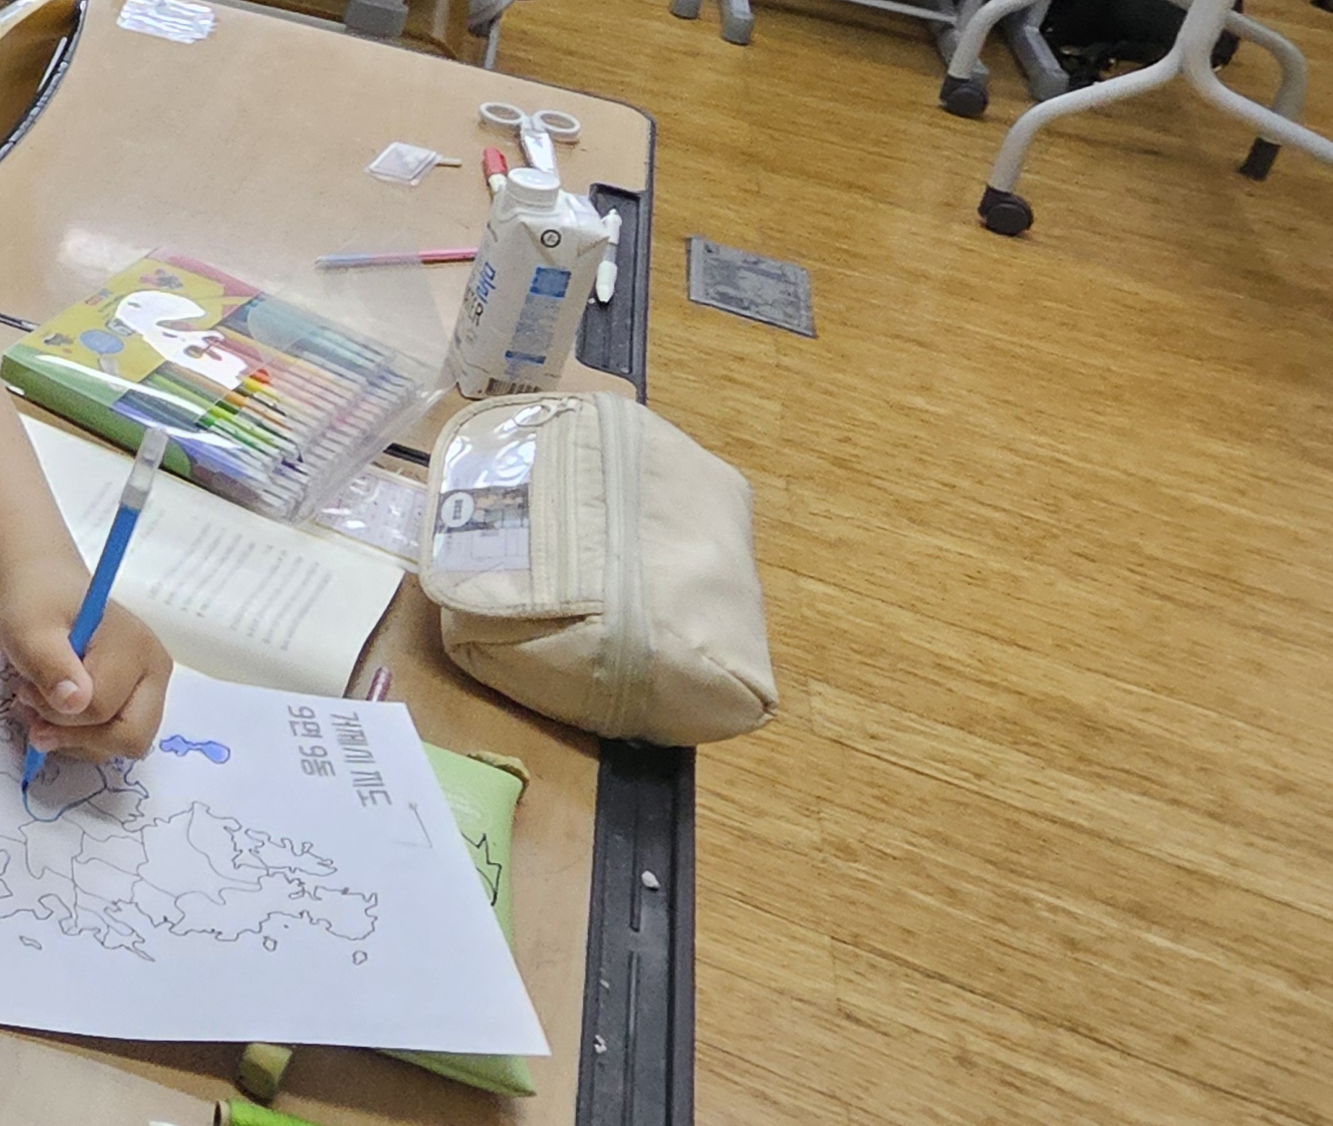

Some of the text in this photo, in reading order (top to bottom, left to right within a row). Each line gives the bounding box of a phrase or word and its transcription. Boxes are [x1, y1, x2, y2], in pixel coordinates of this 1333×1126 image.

[288, 705, 336, 777] 9면 9동
[330, 712, 393, 808] 거제시 지도
